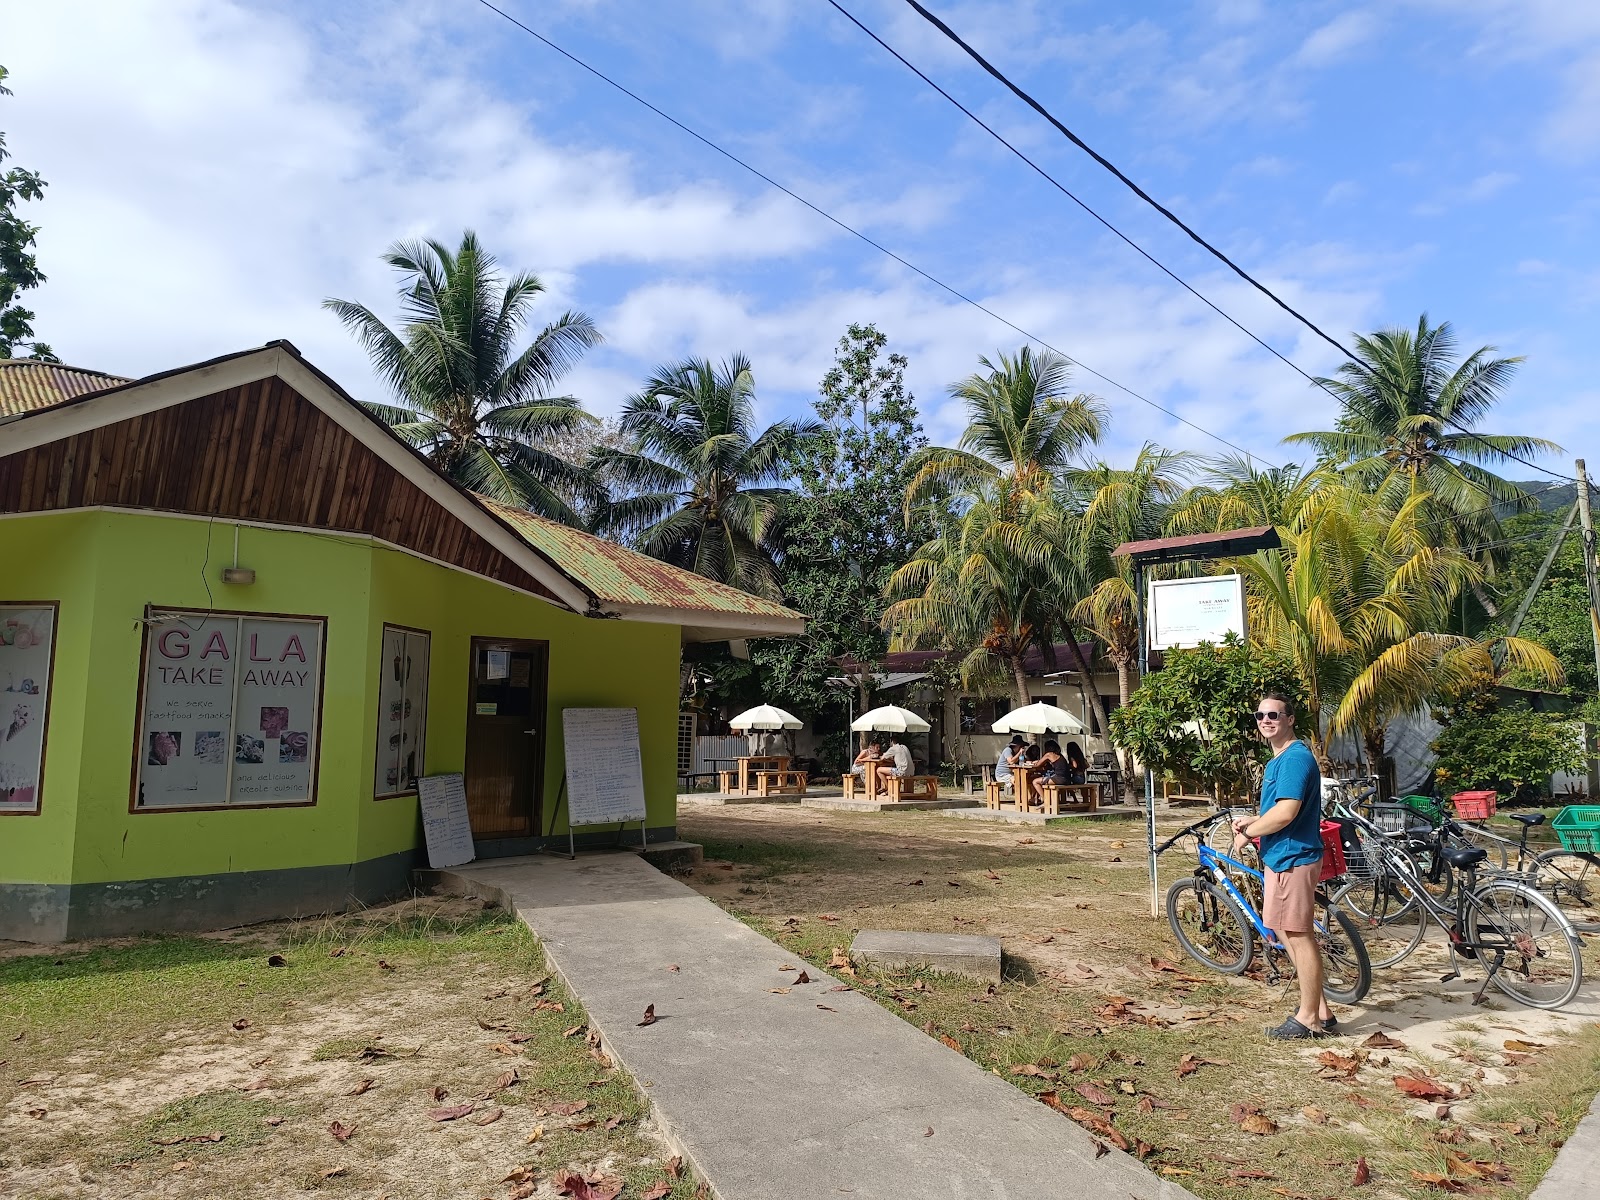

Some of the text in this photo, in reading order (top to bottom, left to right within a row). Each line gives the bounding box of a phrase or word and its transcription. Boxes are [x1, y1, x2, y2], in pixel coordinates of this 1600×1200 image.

[157, 665, 309, 687] TAKE AWAY
[147, 711, 231, 723] fastfood snacks
[258, 773, 296, 781] delicious
[239, 782, 303, 793] creole cuisine
